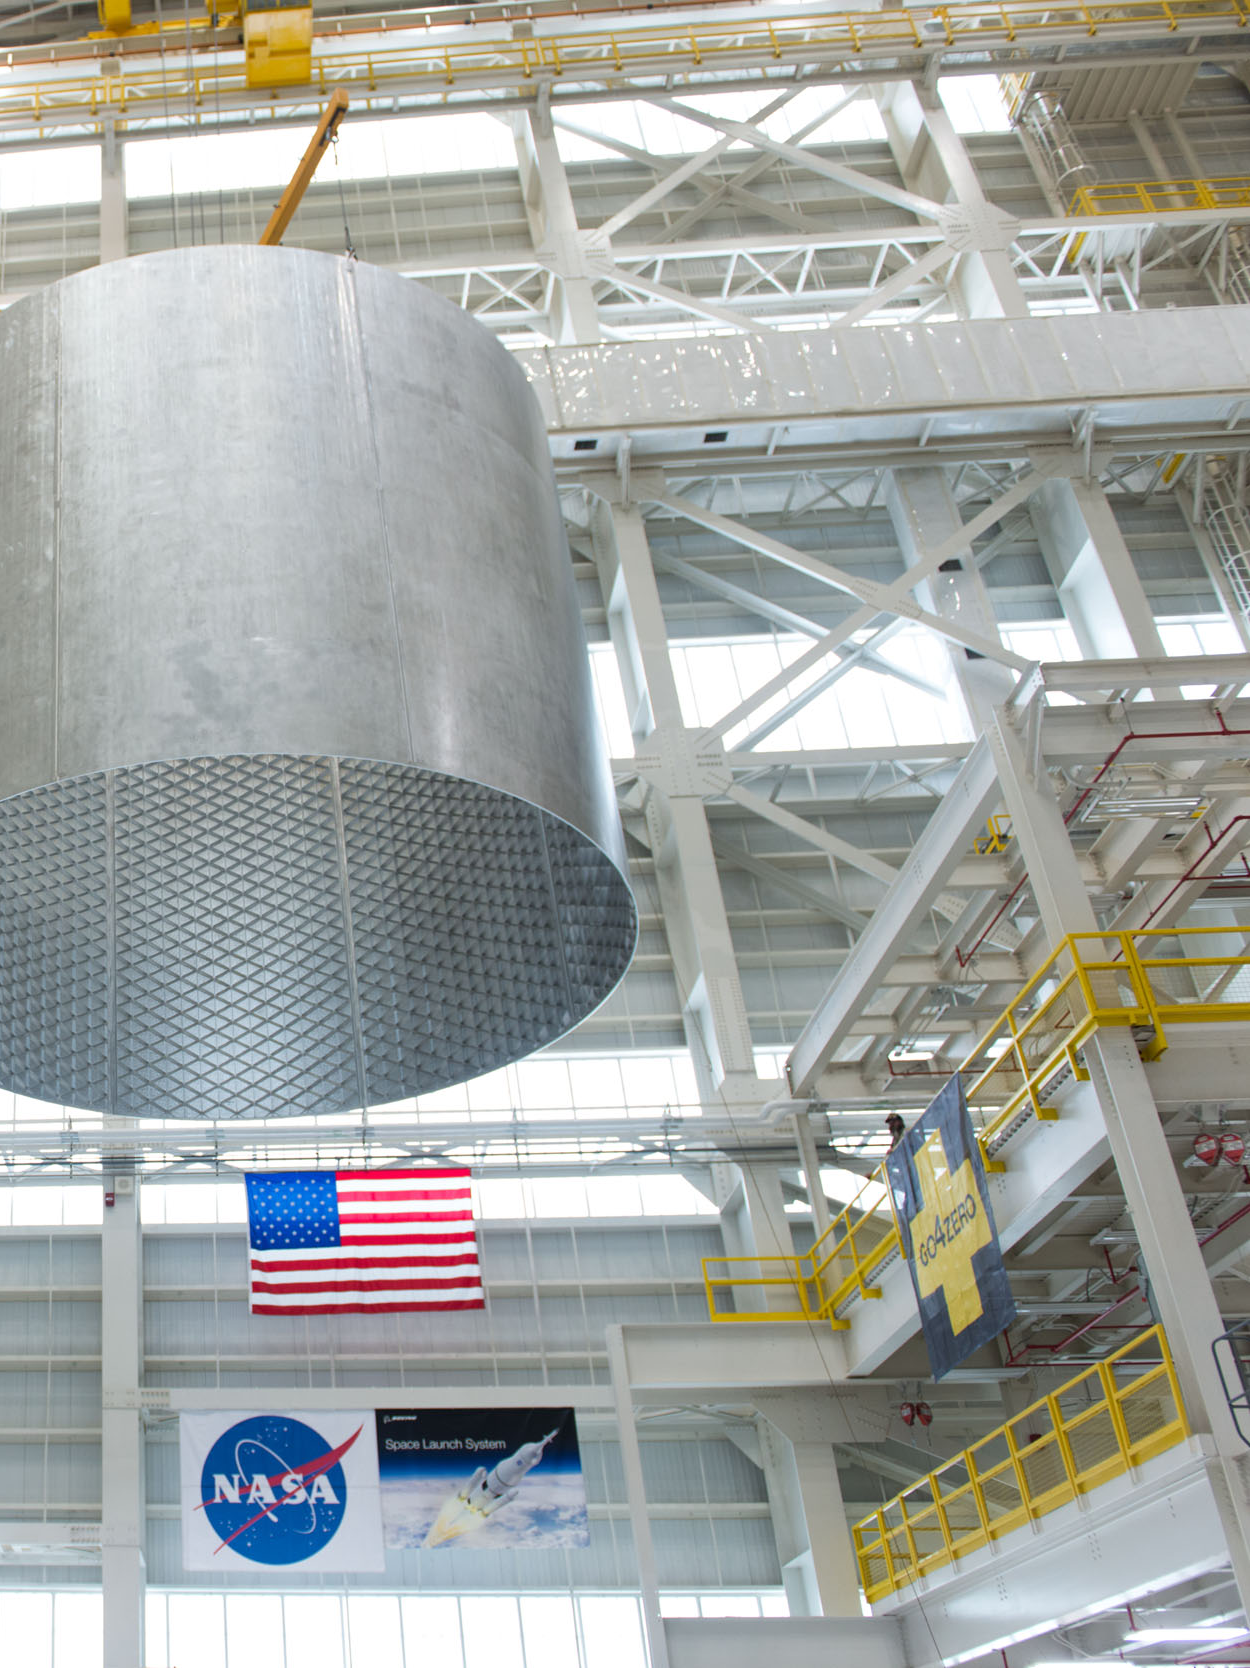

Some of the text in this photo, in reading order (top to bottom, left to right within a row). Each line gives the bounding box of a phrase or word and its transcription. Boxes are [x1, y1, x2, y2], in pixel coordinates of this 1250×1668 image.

[920, 1193, 977, 1266] GO4ZERO
[385, 1437, 507, 1452] Space Launch System
[212, 1473, 340, 1505] NASA
